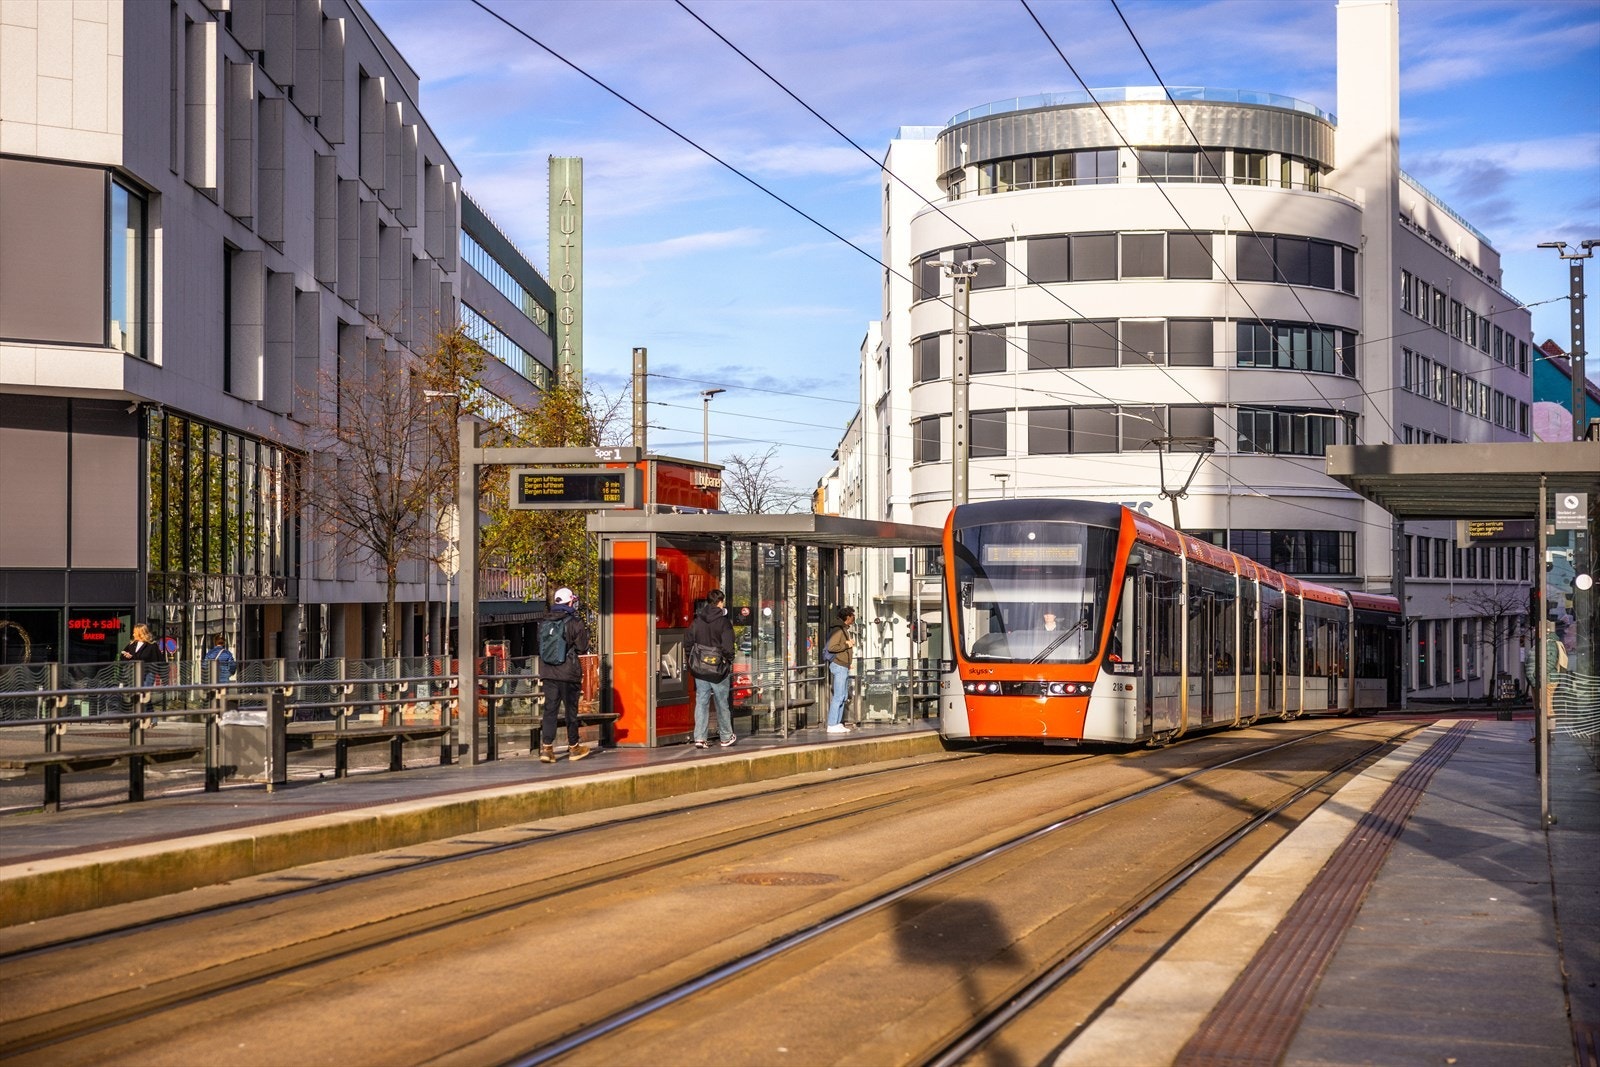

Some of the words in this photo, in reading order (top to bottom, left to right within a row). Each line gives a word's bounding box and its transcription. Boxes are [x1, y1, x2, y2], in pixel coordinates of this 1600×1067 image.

[595, 448, 613, 459] Spor
[614, 449, 622, 460] 1
[524, 488, 543, 496] Bergen
[68, 618, 91, 629] søtt
[101, 618, 121, 629] salt
[969, 667, 988, 676] skyss
[1112, 682, 1124, 692] 218
